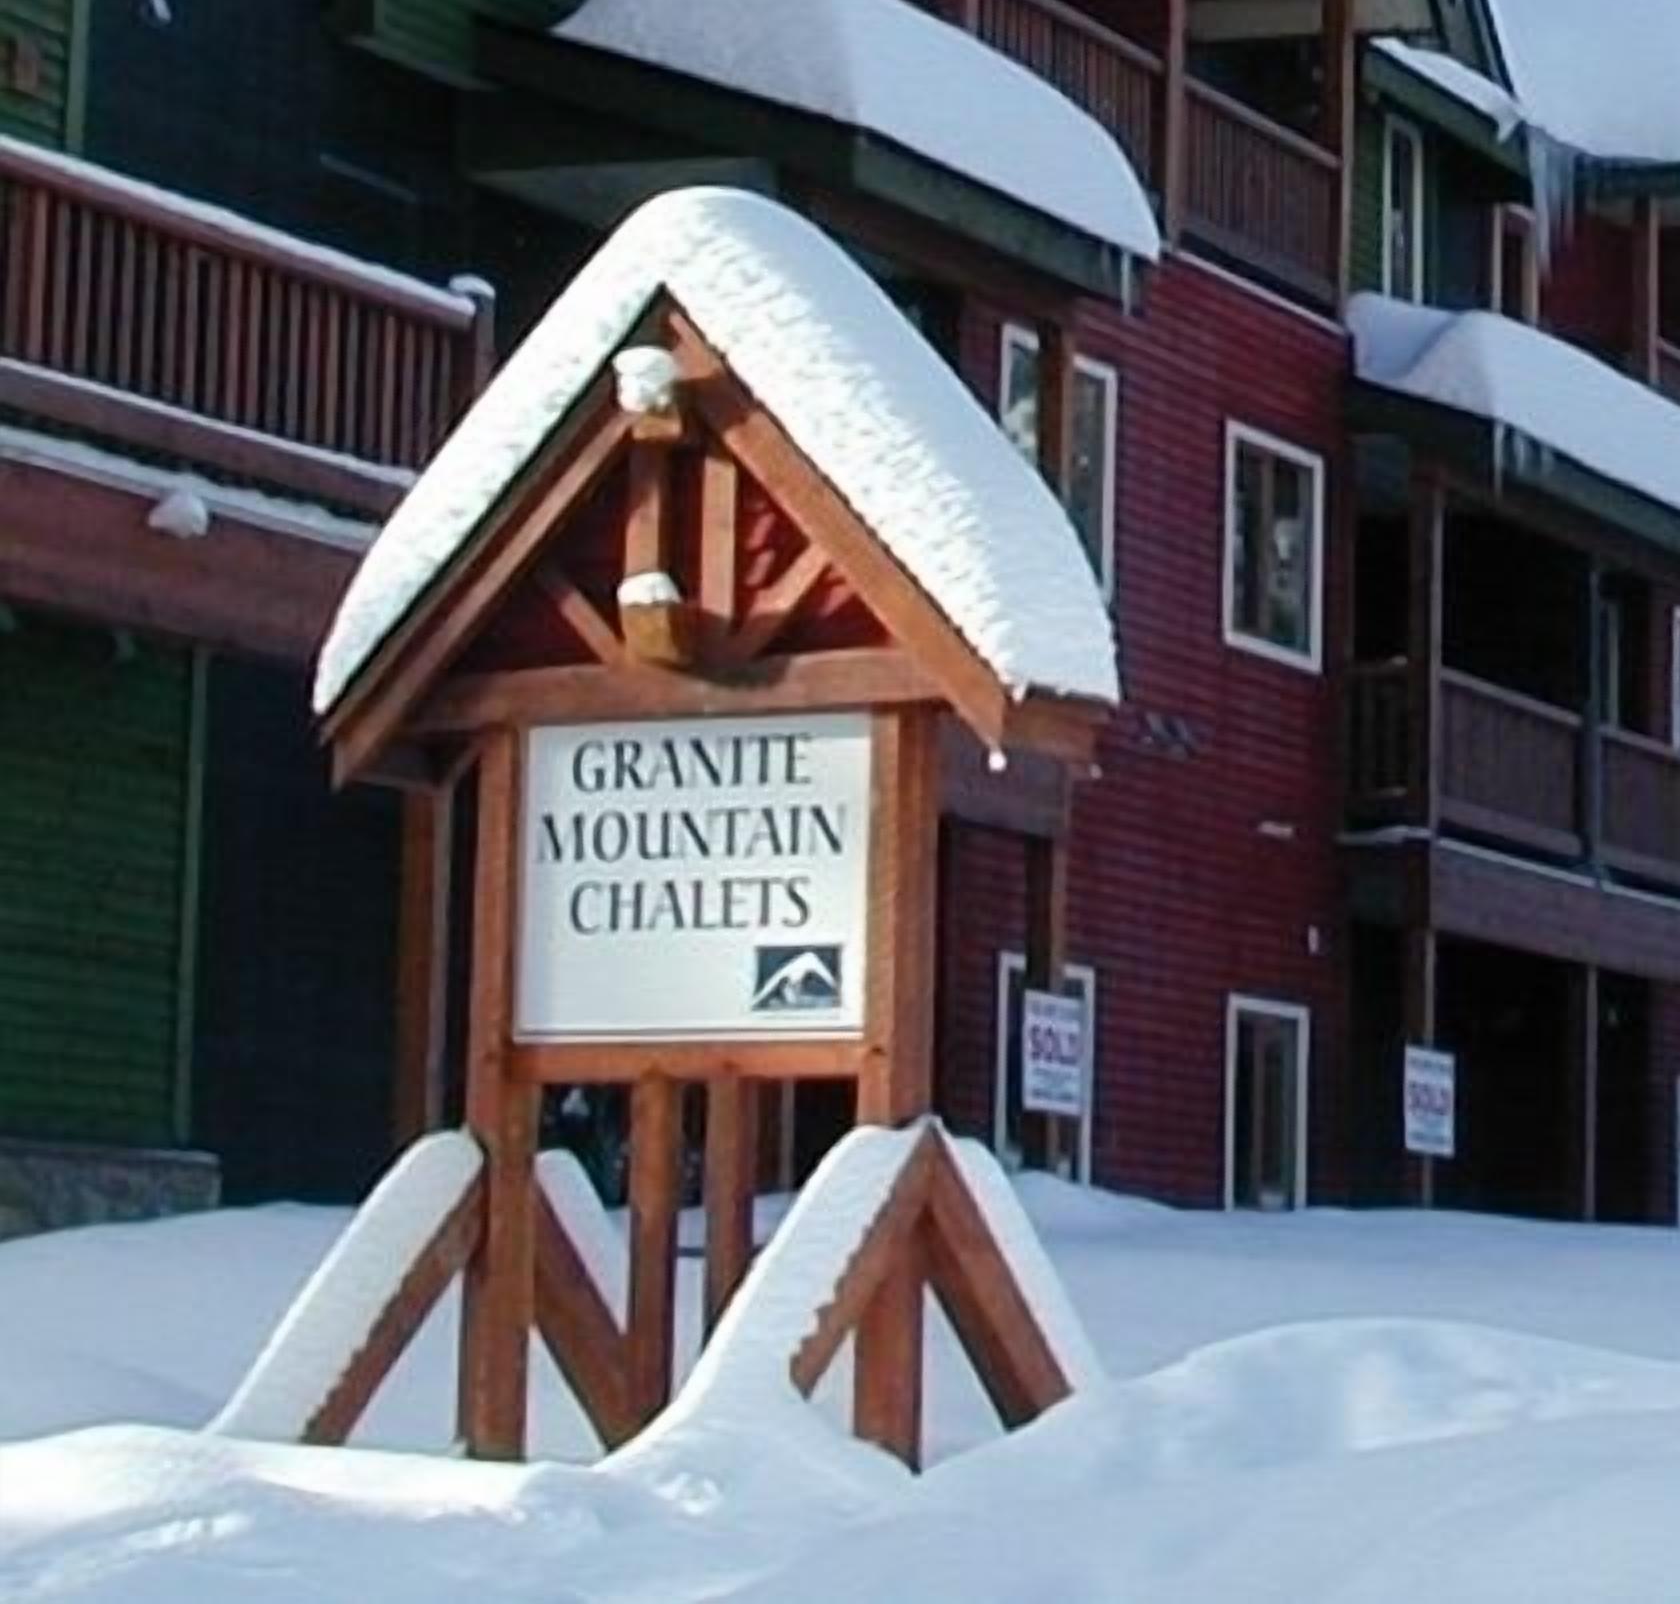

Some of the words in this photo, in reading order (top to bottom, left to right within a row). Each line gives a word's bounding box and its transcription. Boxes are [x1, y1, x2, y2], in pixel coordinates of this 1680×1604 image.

[572, 733, 813, 792] GRANITE
[538, 804, 846, 863] MOUNTAIN
[569, 876, 812, 935] CHALETS
[1031, 1024, 1083, 1065] SOLD
